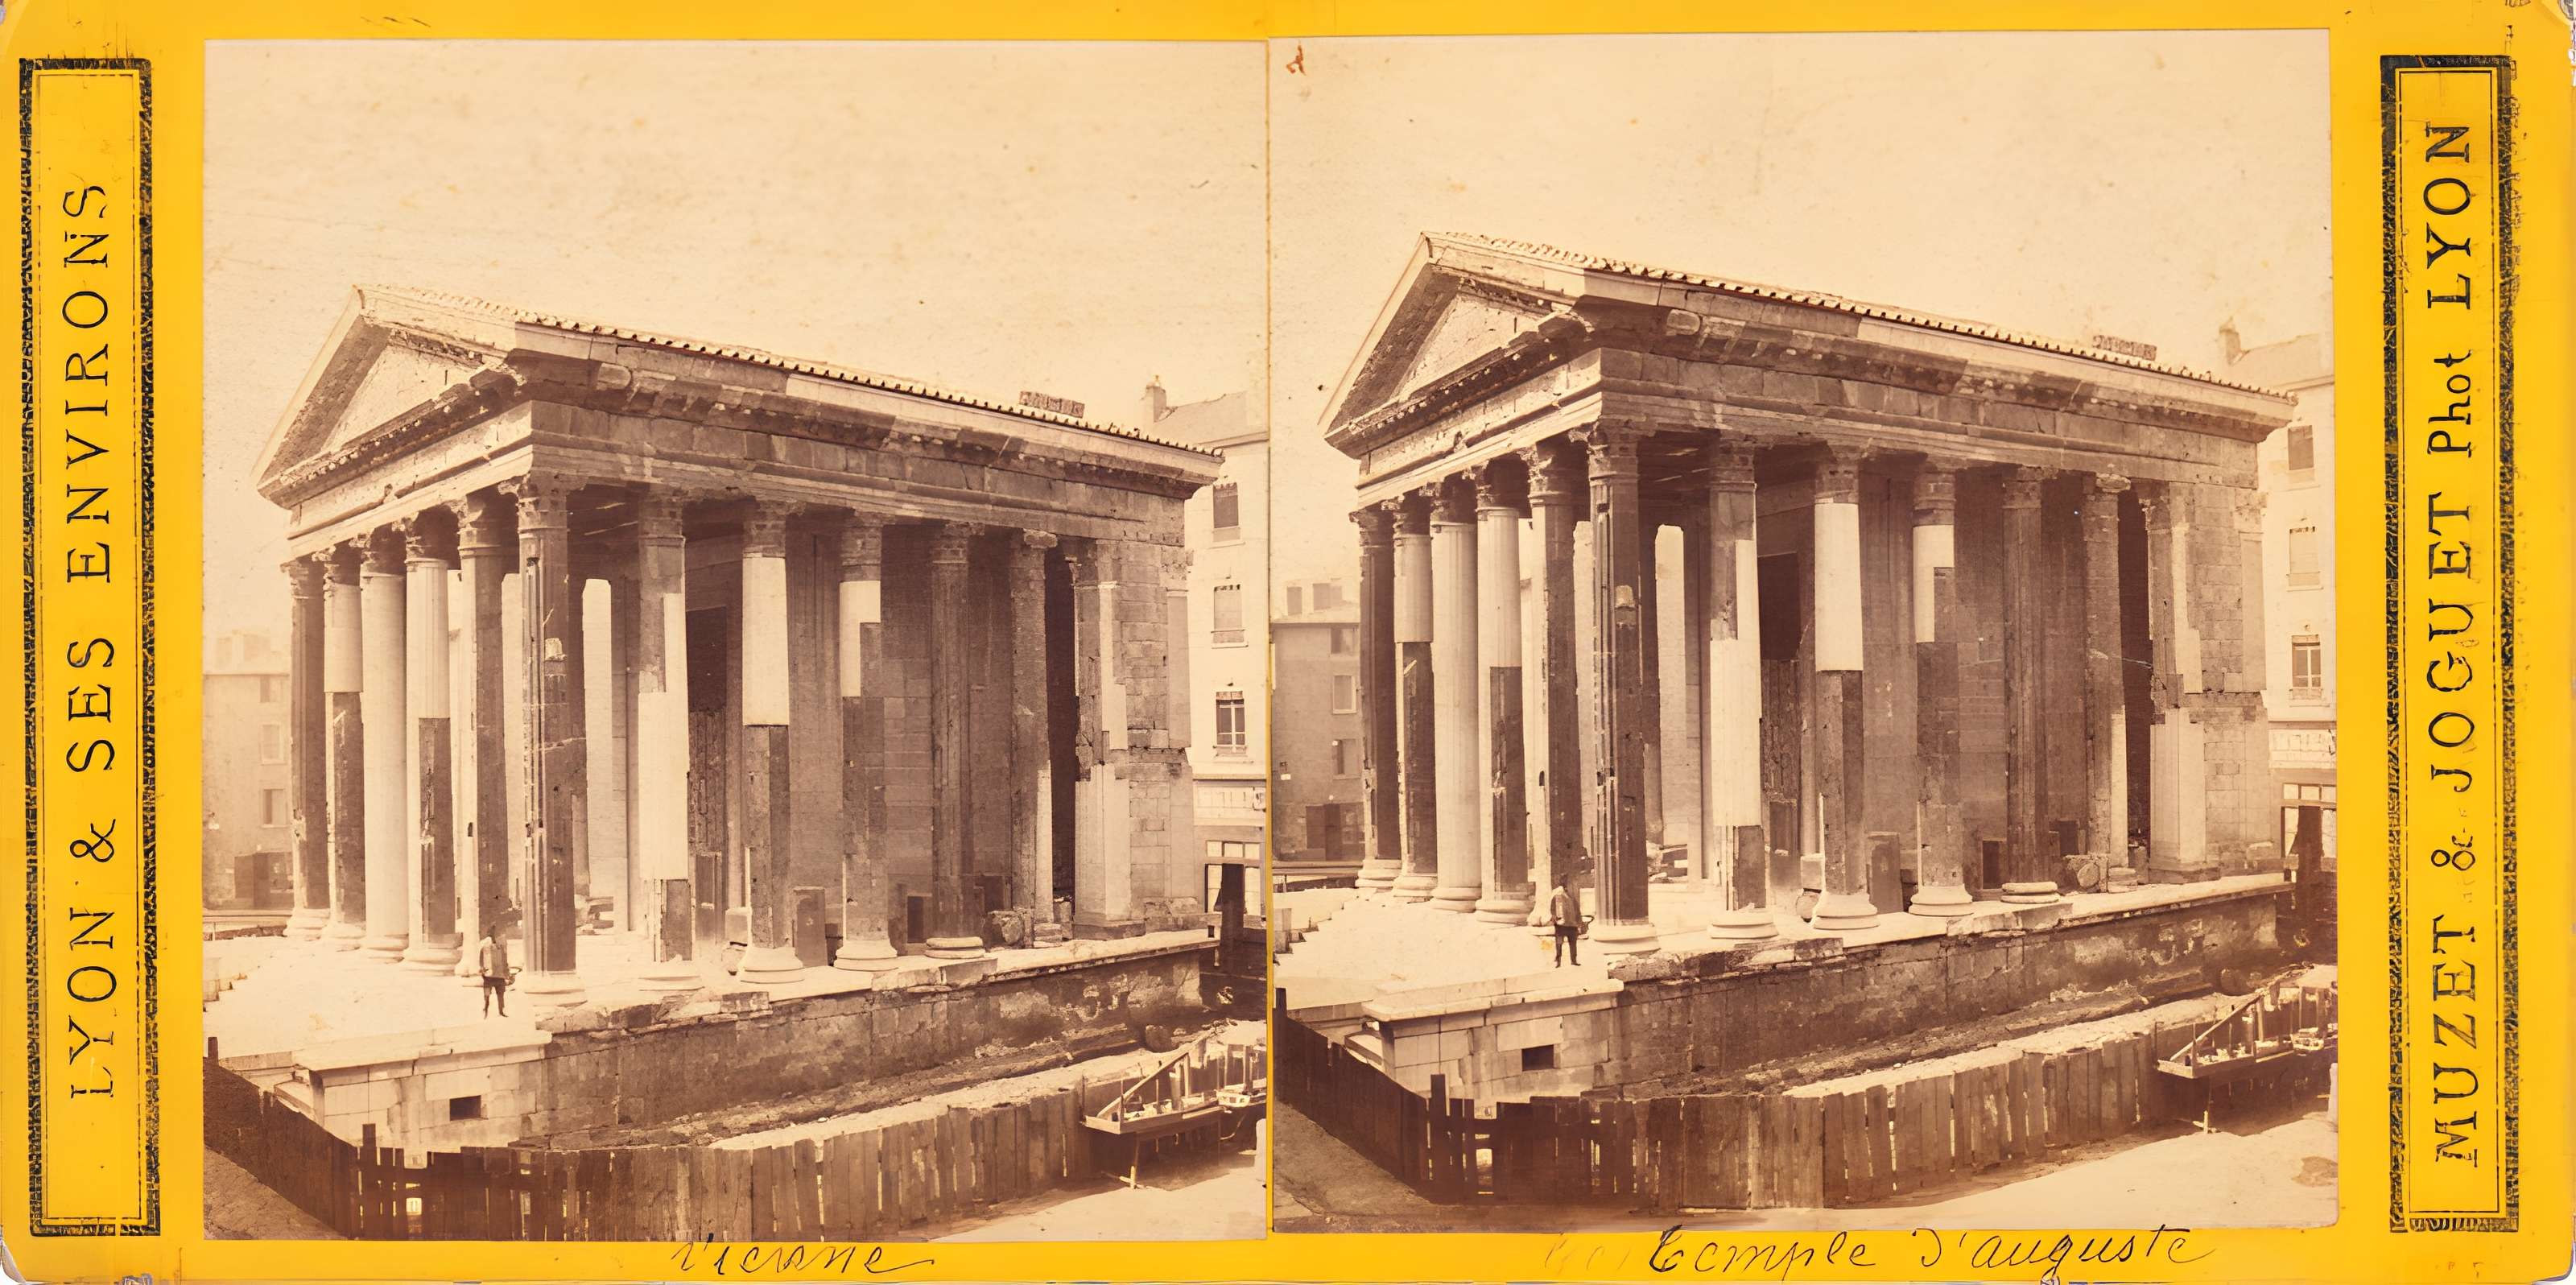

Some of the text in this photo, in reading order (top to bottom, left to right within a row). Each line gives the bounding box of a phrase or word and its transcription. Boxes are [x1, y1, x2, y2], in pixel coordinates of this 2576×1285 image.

[62, 185, 117, 1099] LYON & SES ENVIRONS
[2423, 122, 2479, 1167] MUZET & JOGUET Phot LYON
